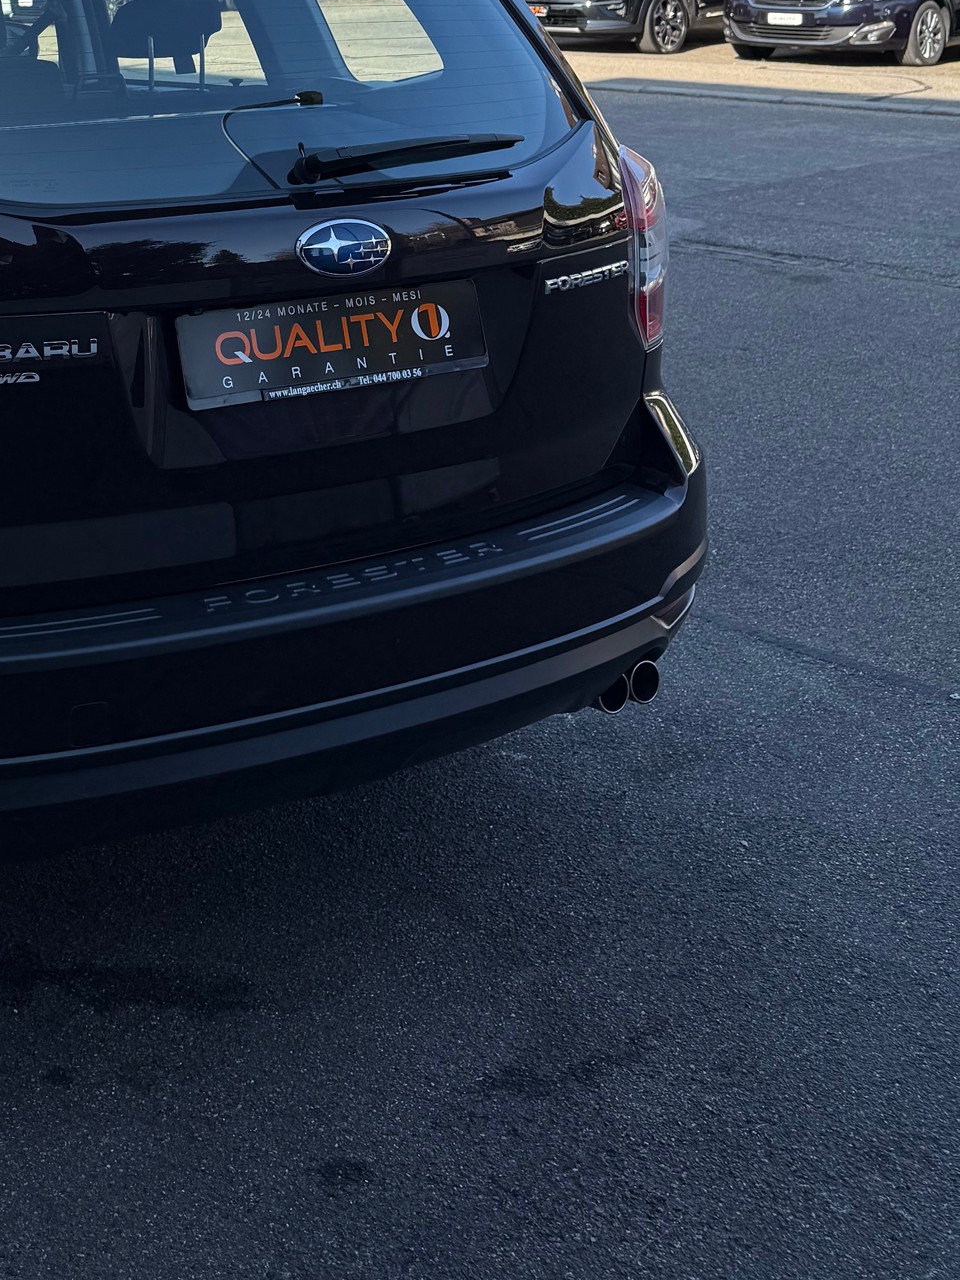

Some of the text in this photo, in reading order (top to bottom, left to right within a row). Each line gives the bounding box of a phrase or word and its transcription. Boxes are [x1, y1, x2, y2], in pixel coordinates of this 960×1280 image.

[544, 259, 629, 295] FORESTER
[236, 308, 271, 322] 12/24
[277, 301, 328, 317] MONATE
[345, 295, 376, 308] MOIS
[392, 290, 421, 302] MESI
[214, 309, 404, 366] QUALITY
[223, 344, 454, 389] GARANTIE
[268, 367, 422, 399] www.langaecher.ch Tel. 044 700 03 56
[201, 541, 504, 613] FORESTER
